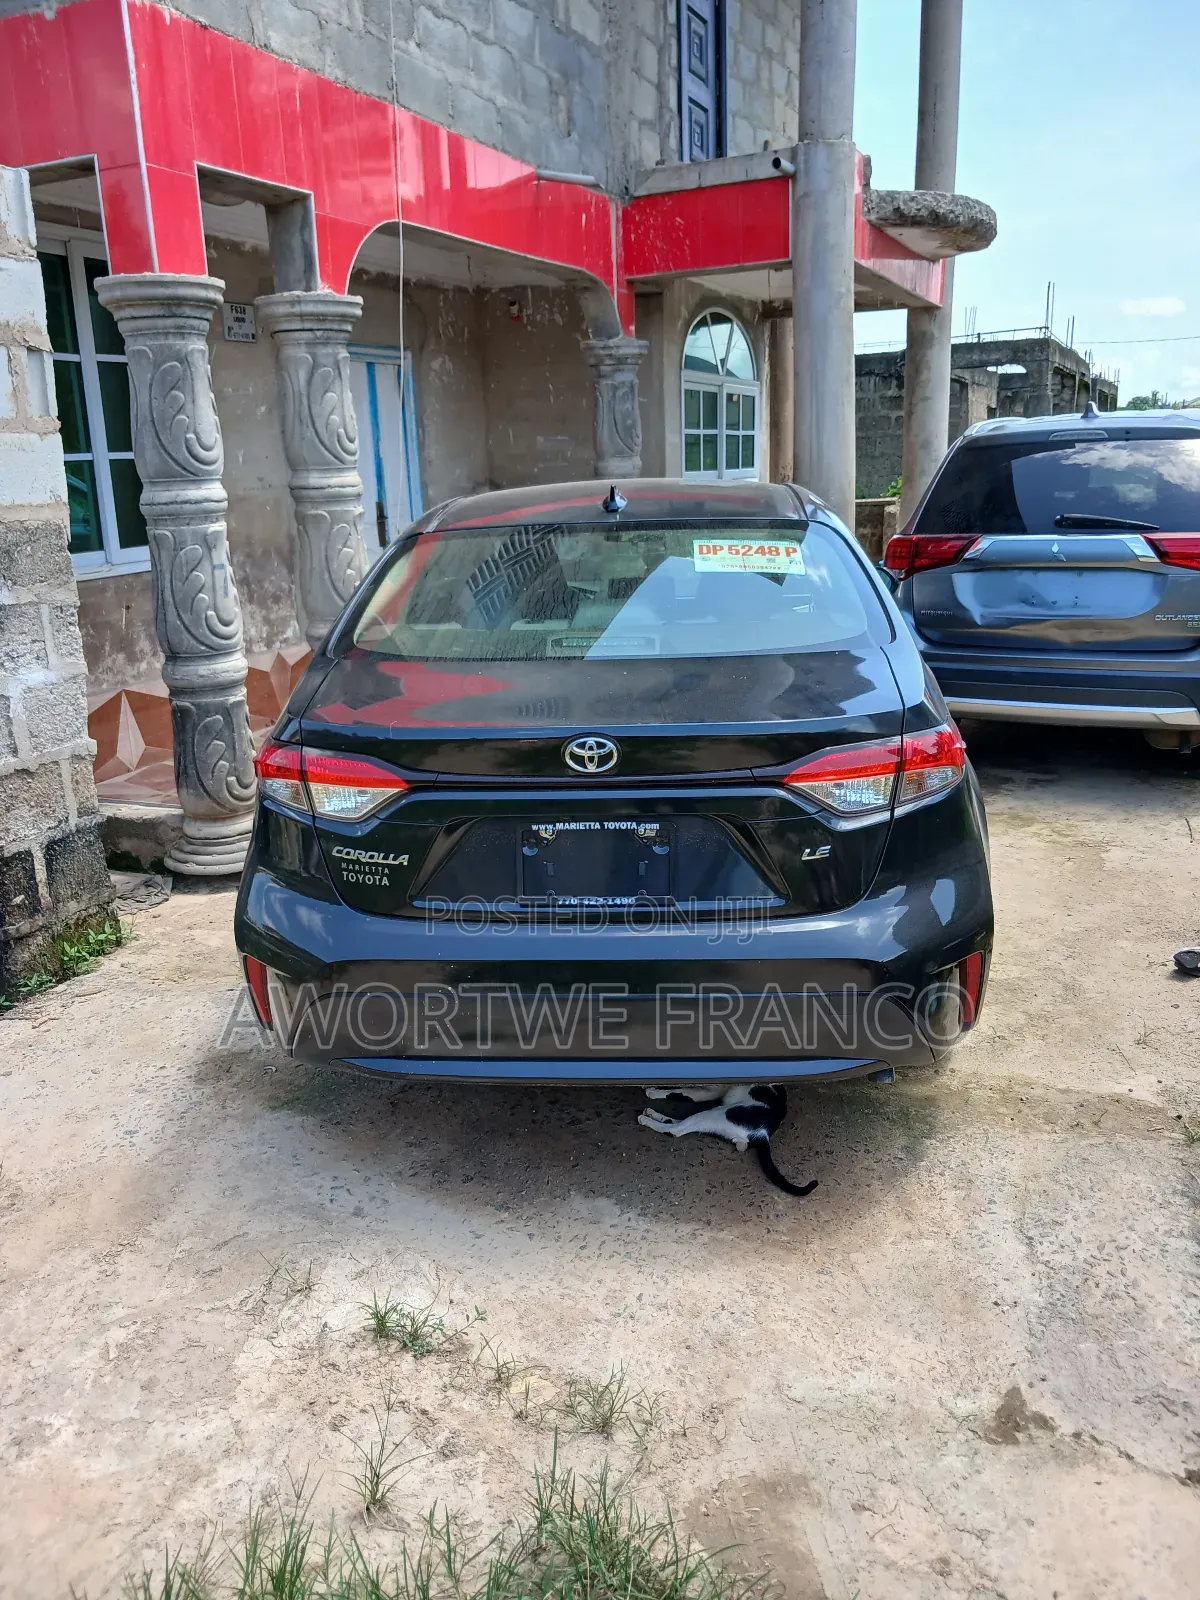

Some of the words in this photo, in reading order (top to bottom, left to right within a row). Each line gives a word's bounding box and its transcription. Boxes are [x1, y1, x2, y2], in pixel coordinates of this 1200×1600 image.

[698, 544, 724, 556] DP
[727, 544, 781, 557] 5248
[784, 546, 798, 557] P
[332, 845, 410, 866] COROLLA
[801, 845, 832, 861] LE
[341, 862, 390, 875] MARIETTA
[342, 871, 390, 887] TOYOTA
